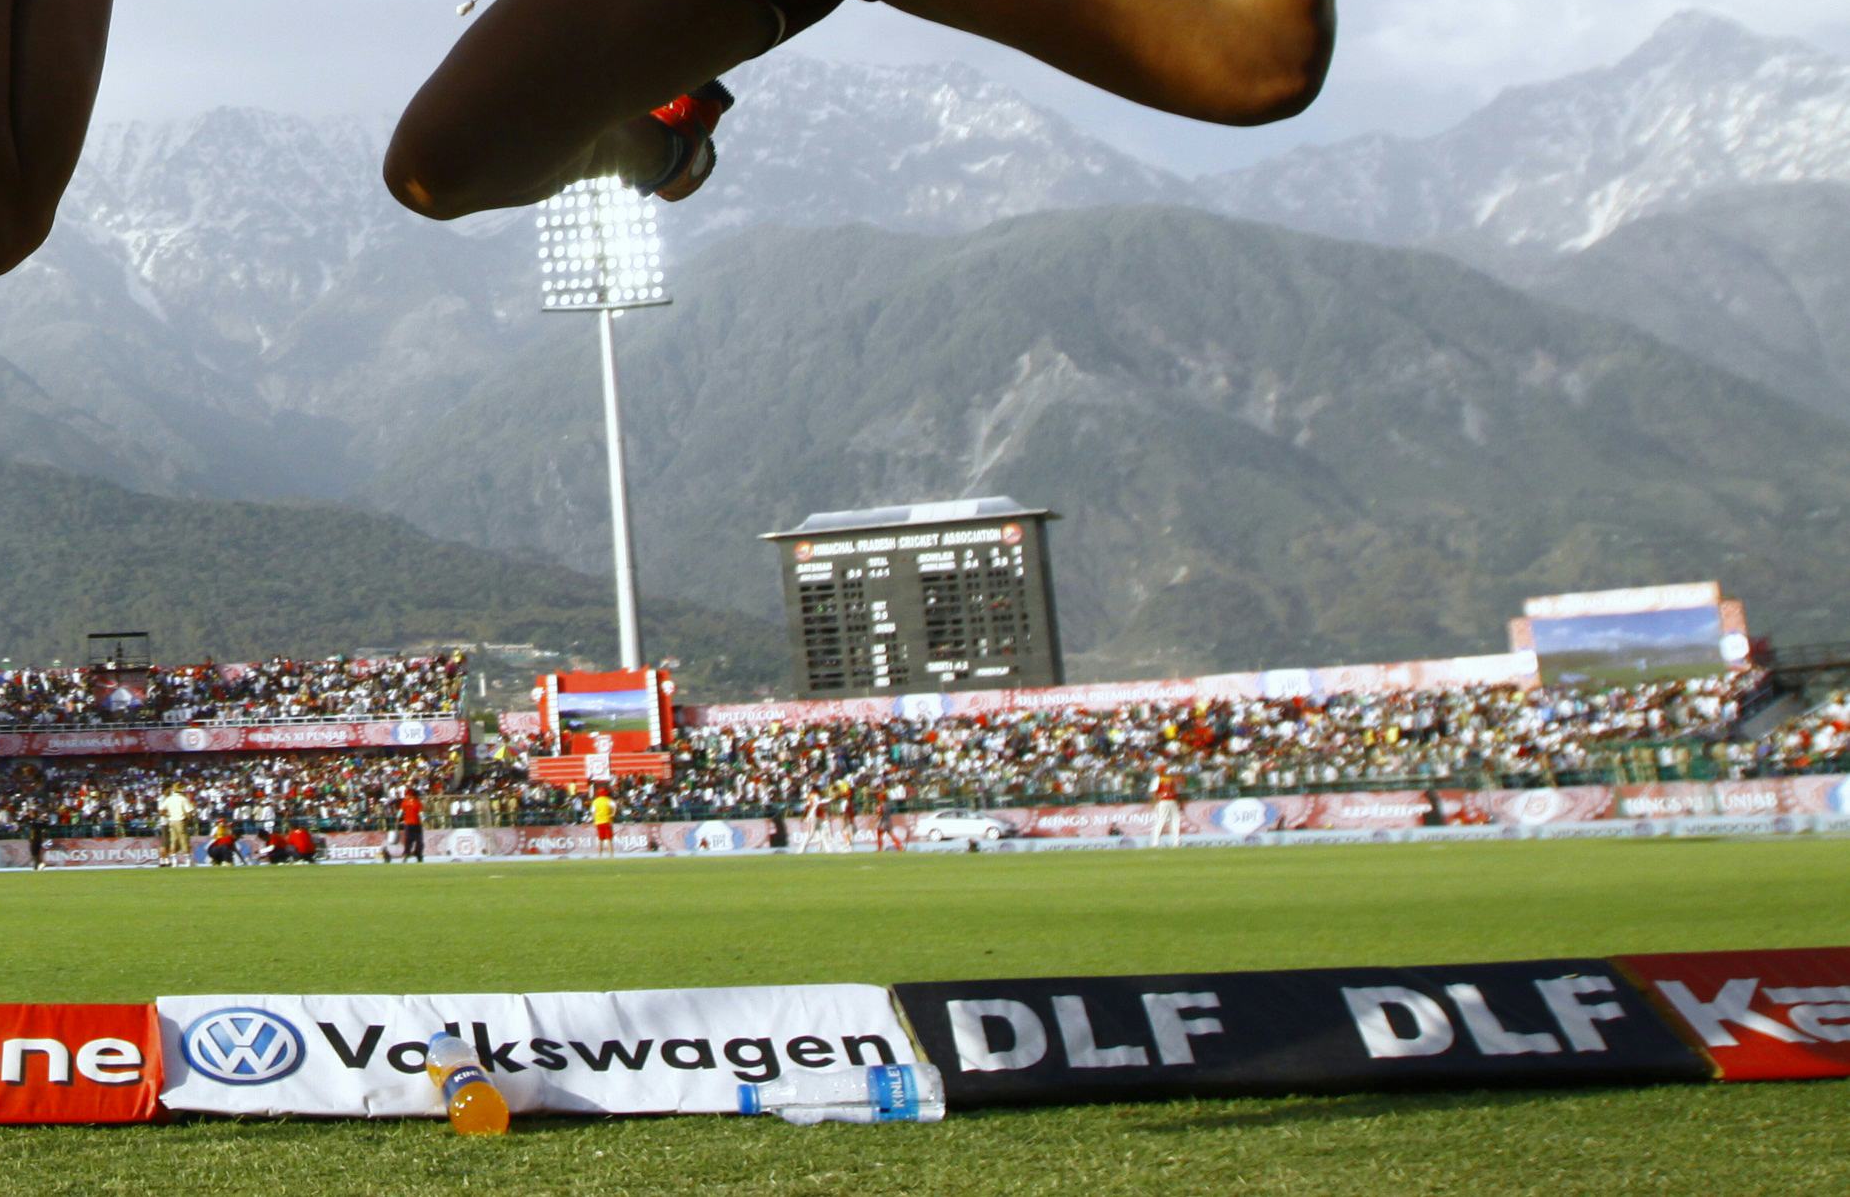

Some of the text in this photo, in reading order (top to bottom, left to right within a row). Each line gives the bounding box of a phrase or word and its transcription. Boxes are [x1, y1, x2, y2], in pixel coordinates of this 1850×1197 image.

[898, 533, 940, 550] CRICKET
[941, 528, 1002, 546] ASSOCIATION
[306, 729, 347, 741] PUNJAB
[43, 847, 159, 862] KINGS XI PUNJAB
[946, 975, 1627, 1072] DLF DLF
[886, 1064, 906, 1109] KINLE
